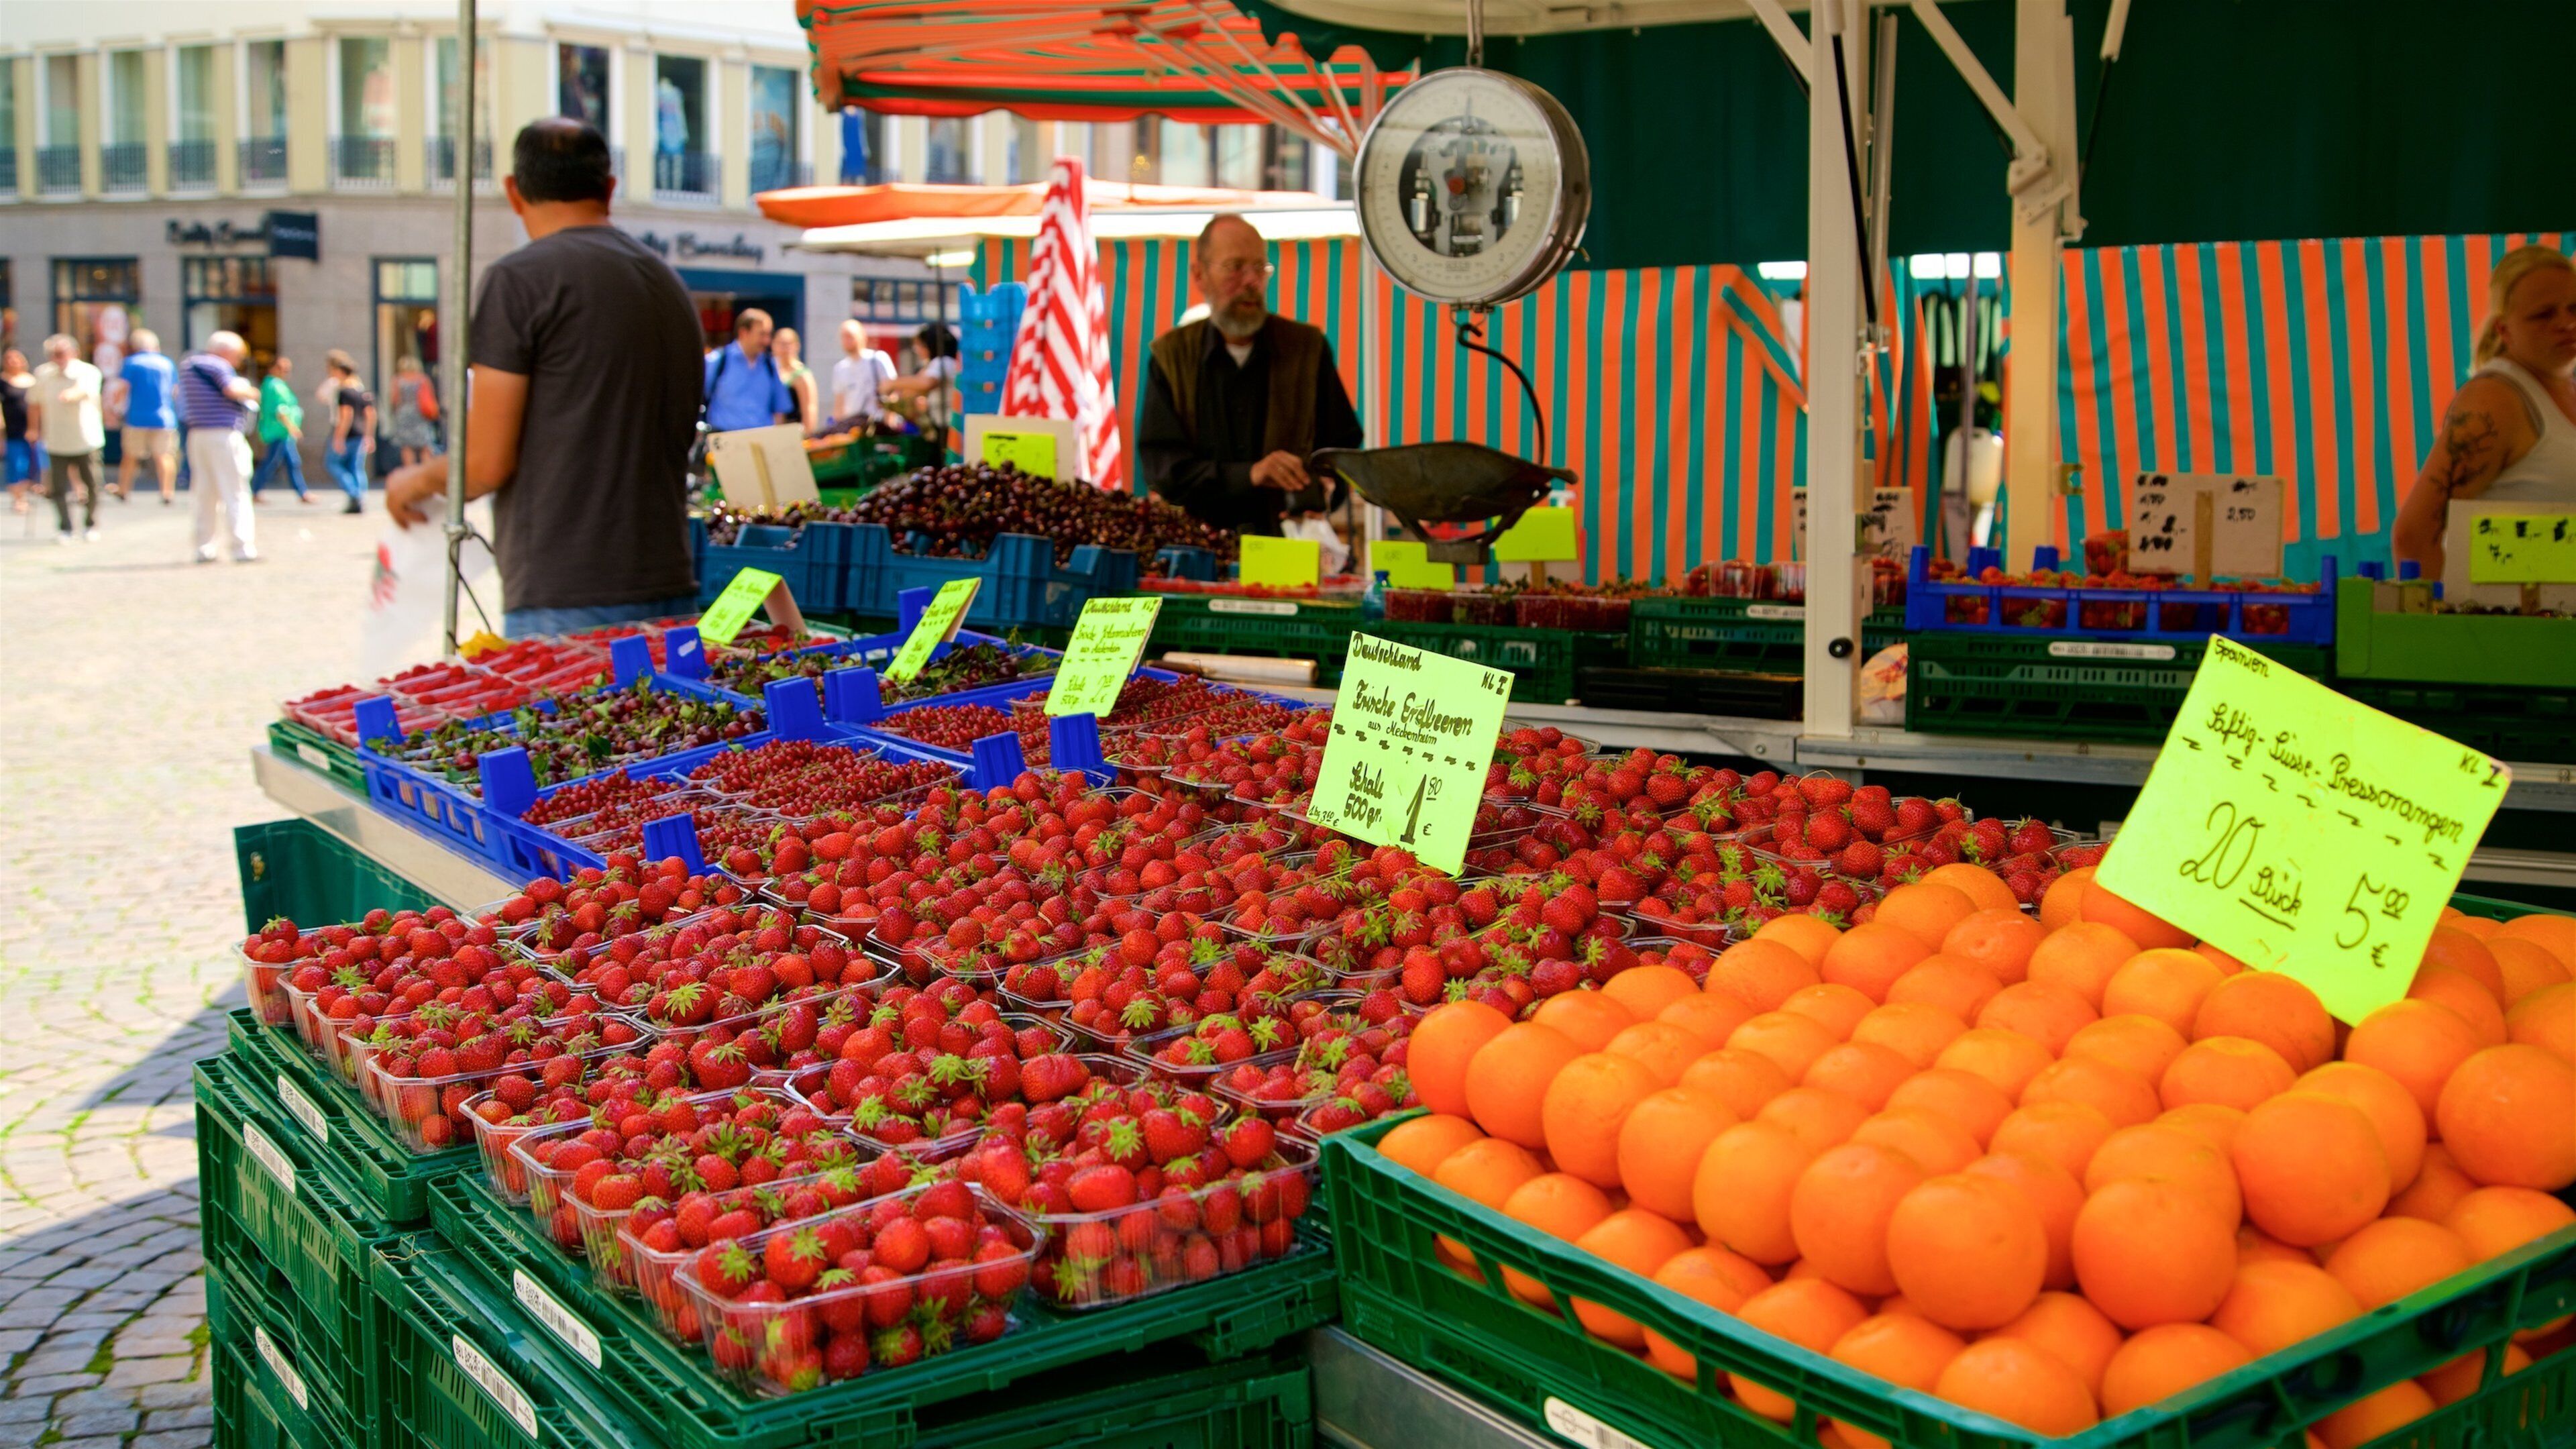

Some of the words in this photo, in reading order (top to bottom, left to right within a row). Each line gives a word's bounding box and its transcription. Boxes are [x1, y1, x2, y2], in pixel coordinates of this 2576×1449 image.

[1352, 633, 1422, 672] Deutschland
[2214, 639, 2269, 678] Spanien
[1352, 679, 1396, 718] Frische
[1401, 692, 1474, 737] Erdbeeren
[1368, 720, 1382, 732] aus
[1423, 822, 1432, 837] €
[2179, 801, 2265, 890] 20
[2249, 866, 2302, 916] Stück
[2371, 943, 2390, 969] €
